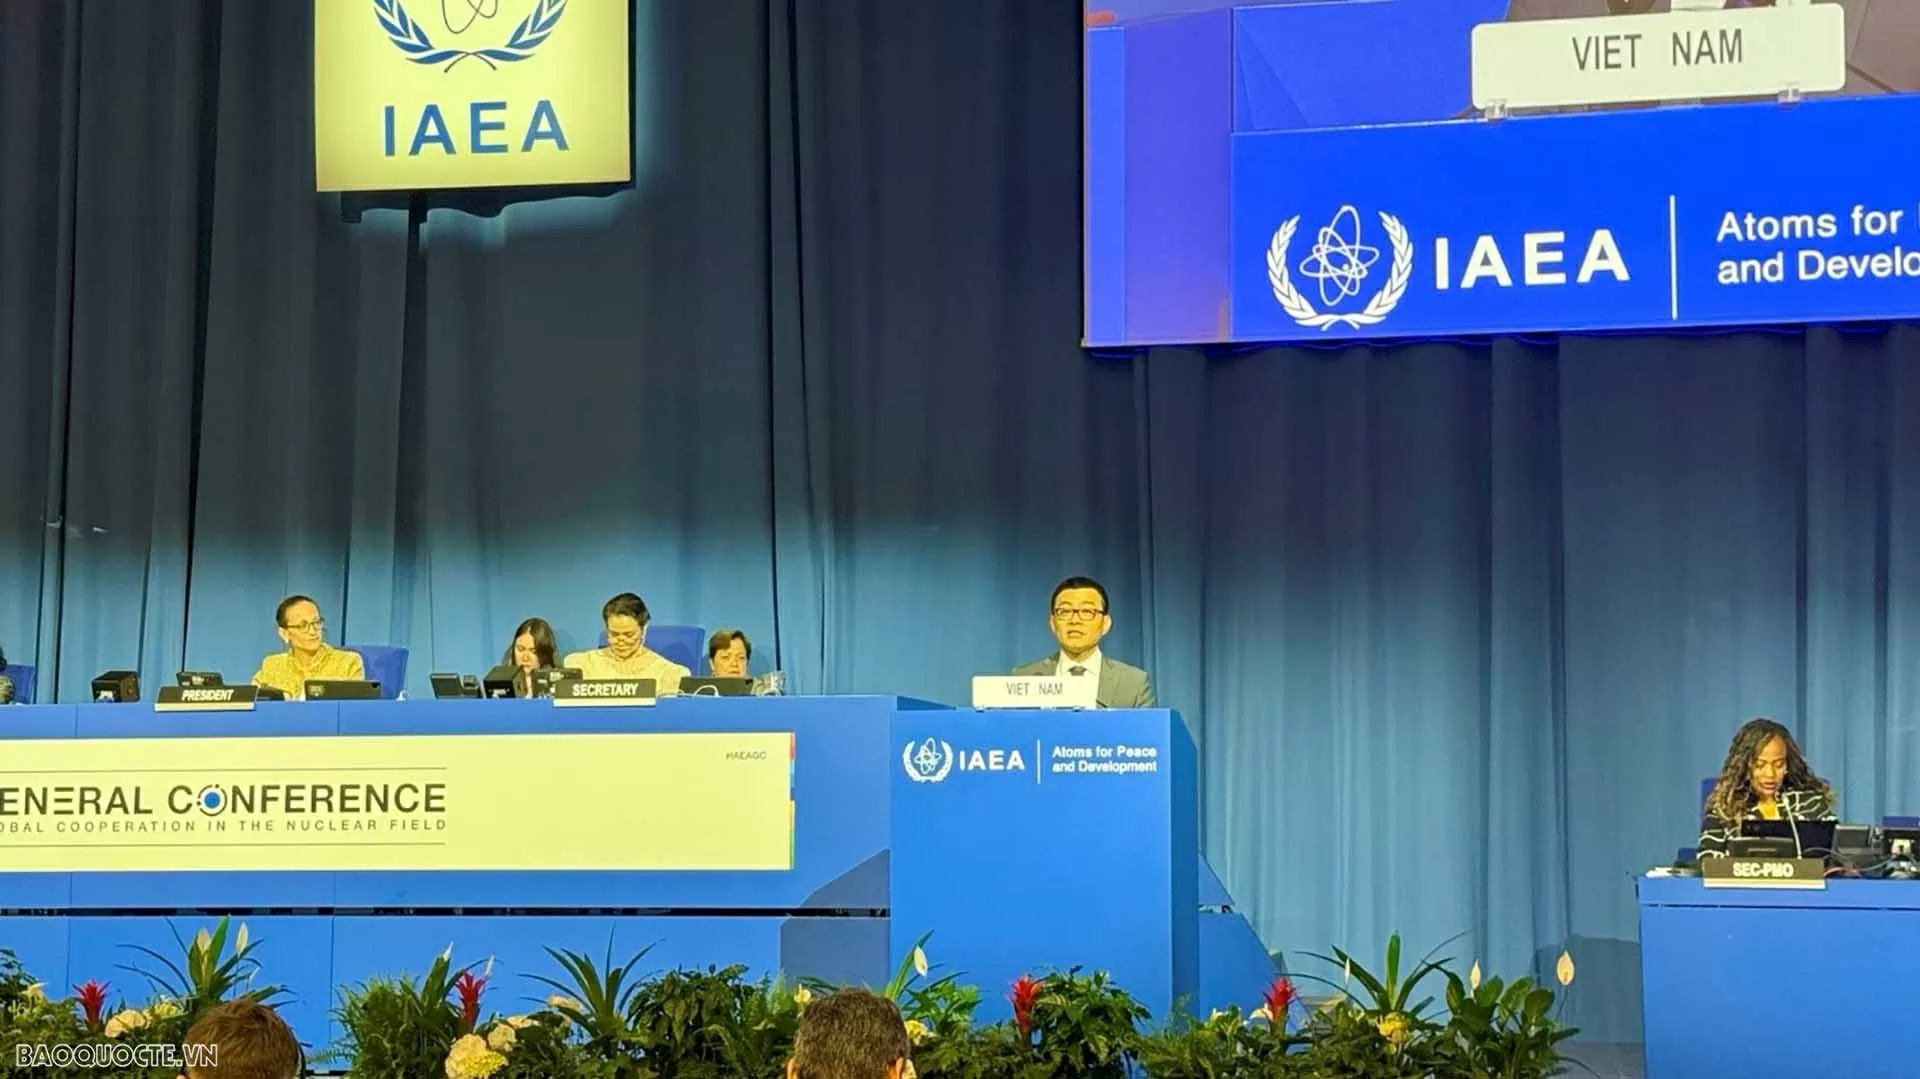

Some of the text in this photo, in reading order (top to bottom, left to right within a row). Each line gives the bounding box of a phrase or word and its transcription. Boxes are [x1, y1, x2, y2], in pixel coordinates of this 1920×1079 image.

[1572, 28, 1743, 71] VIET NAM
[384, 99, 570, 157] IAEA
[1716, 211, 1837, 242] Atoms
[1851, 204, 1904, 236] for
[1435, 229, 1631, 290] IAEA
[1717, 251, 1784, 284] and
[181, 688, 234, 701] PRESIDENT
[572, 683, 639, 696] SECRETARY
[1006, 683, 1064, 696] VIET NAM
[959, 750, 1025, 771] IAEA
[1052, 745, 1157, 758] Atoms for Peace
[1053, 760, 1158, 775] and Development
[168, 783, 446, 817] CONFERENCE
[56, 820, 195, 832] COOPERATION
[207, 820, 226, 831] IN
[239, 820, 274, 831] THE
[286, 819, 377, 831] NUCLEAR
[390, 819, 446, 830] FIELD
[1732, 862, 1793, 878] SEC-PMO
